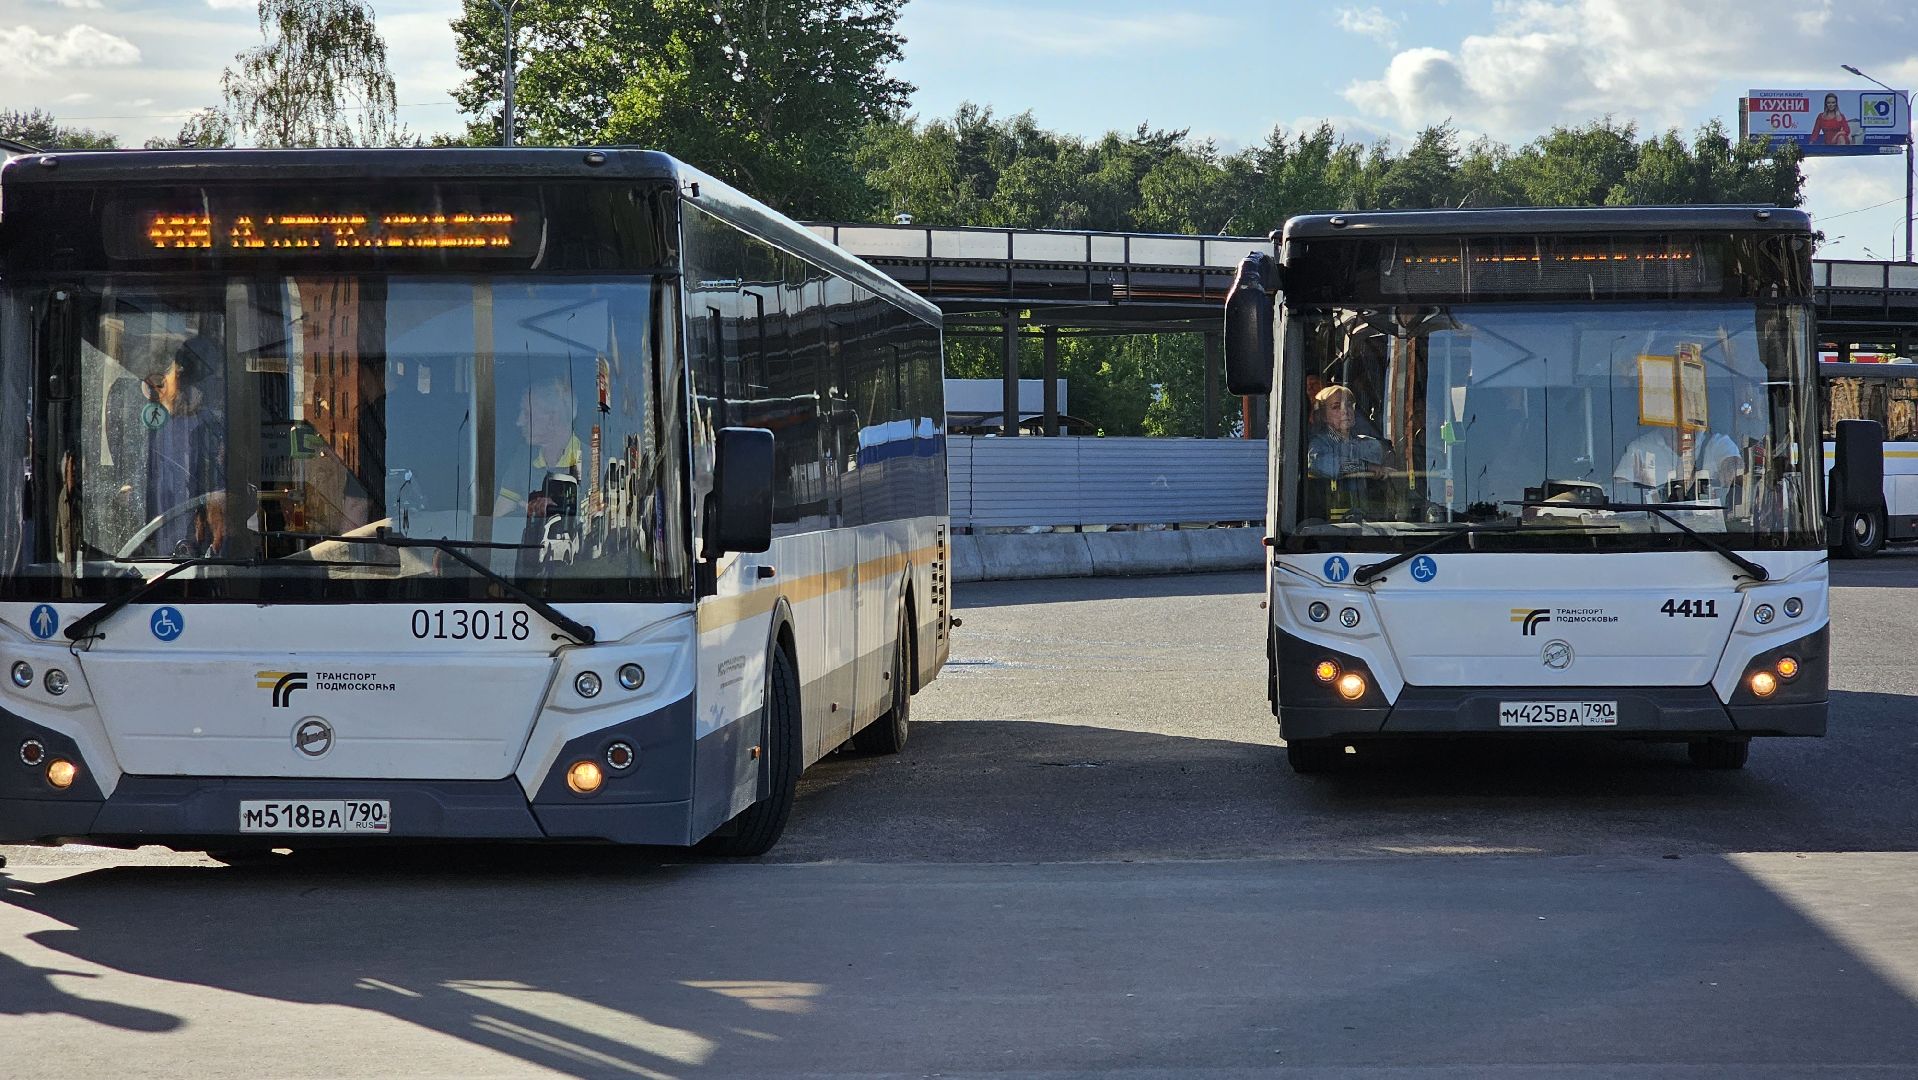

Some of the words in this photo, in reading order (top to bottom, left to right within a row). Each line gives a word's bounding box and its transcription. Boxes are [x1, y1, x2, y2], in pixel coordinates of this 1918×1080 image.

[1759, 99, 1805, 111] КУХНИ
[1660, 598, 1719, 618] 4411
[411, 609, 530, 641] 013018
[316, 672, 377, 681] ТРАНСПОРТ
[316, 682, 396, 691] ПОДМОСКОВЬЯ
[1584, 703, 1612, 718] 790
[347, 802, 383, 822] 790
[355, 821, 374, 829] RUS
